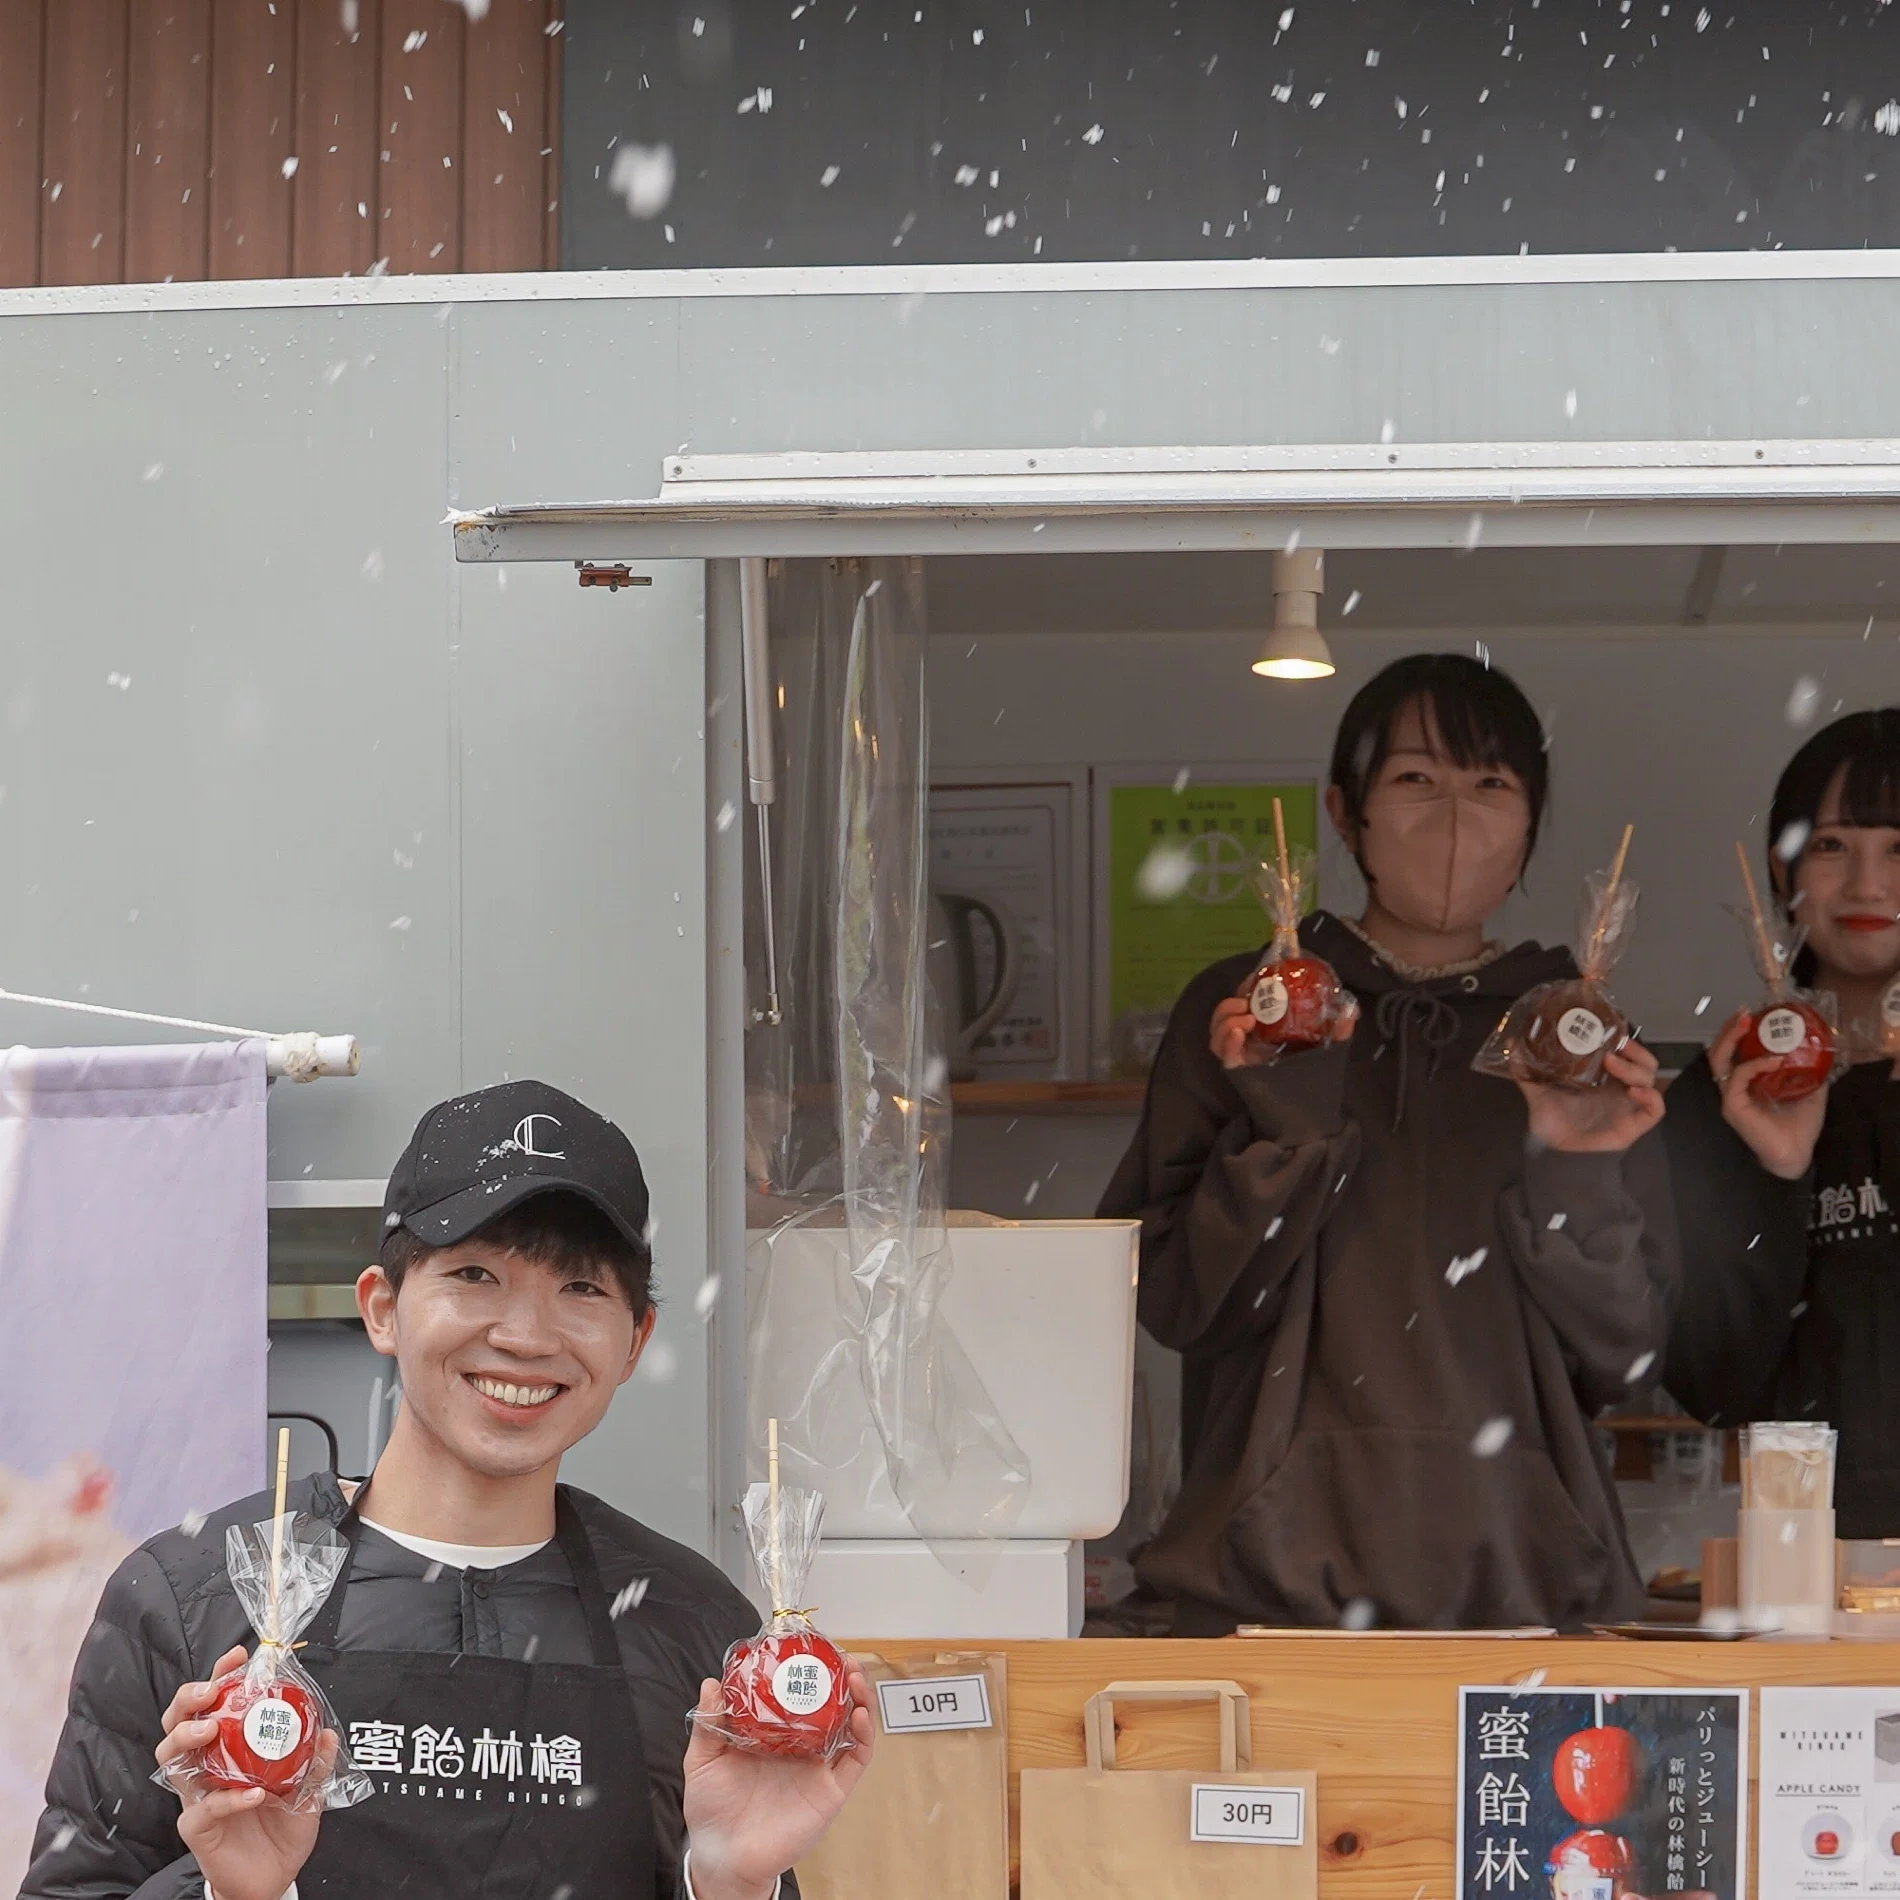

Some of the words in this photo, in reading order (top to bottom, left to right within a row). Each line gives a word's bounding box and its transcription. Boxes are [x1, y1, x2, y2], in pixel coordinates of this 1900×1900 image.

[909, 1693, 958, 1713] 10円
[348, 1720, 582, 1785] 蜜飴林檎
[1695, 1706, 1717, 1888] パリっとジューシー
[1778, 1784, 1813, 1793] APPLE
[1820, 1784, 1861, 1793] CANDY
[508, 1792, 583, 1807] RINGO
[1223, 1803, 1272, 1824] 30円
[1667, 1757, 1686, 1890] 新時代の林檎飴
